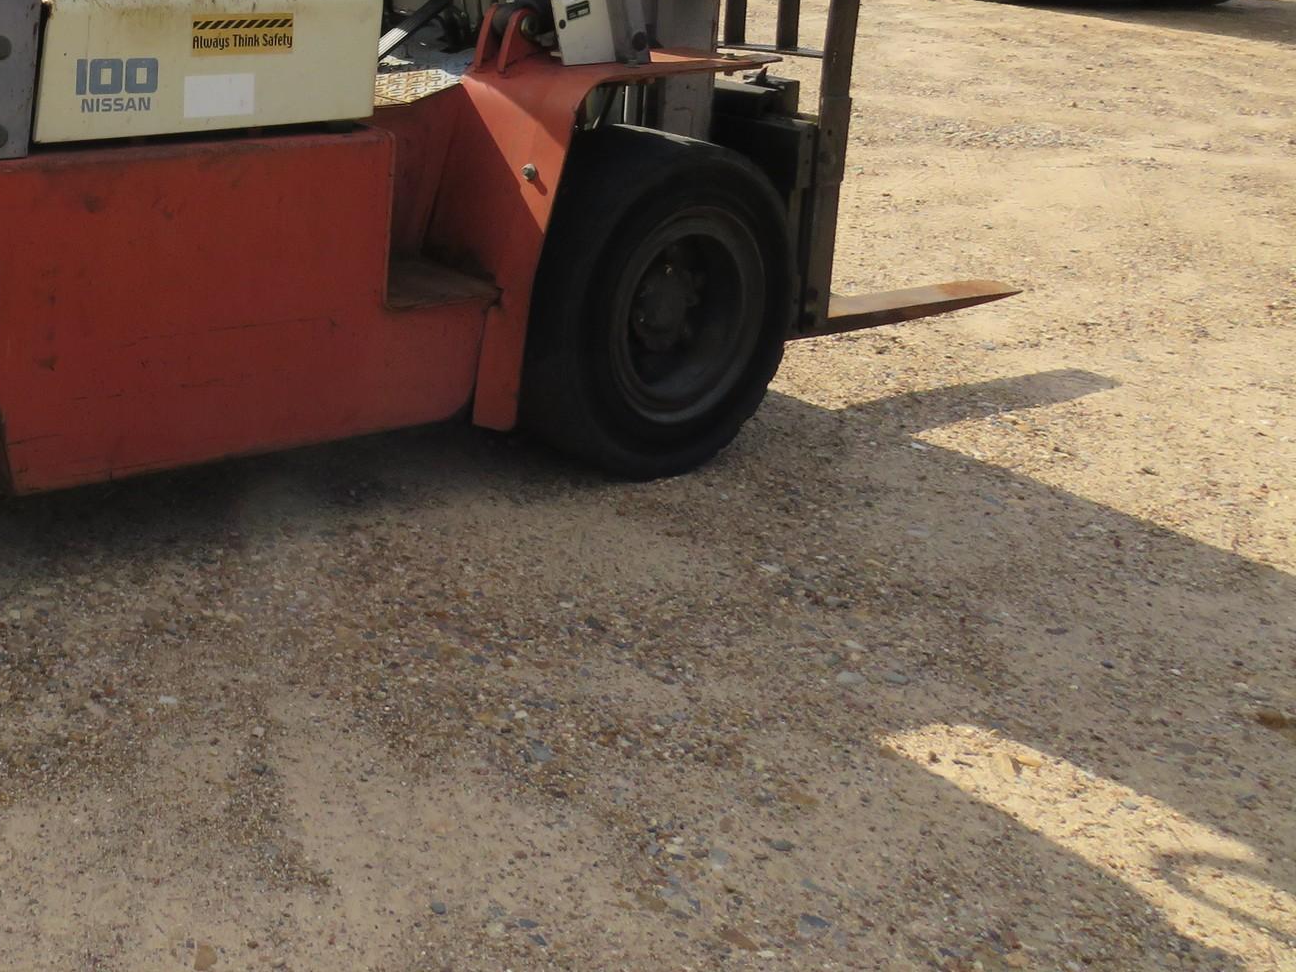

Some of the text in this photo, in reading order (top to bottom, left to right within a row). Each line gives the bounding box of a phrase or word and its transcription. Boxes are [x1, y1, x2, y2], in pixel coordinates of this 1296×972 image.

[192, 33, 293, 50] Always Think Safety
[75, 57, 159, 96] 100
[81, 97, 151, 113] NISSAN
